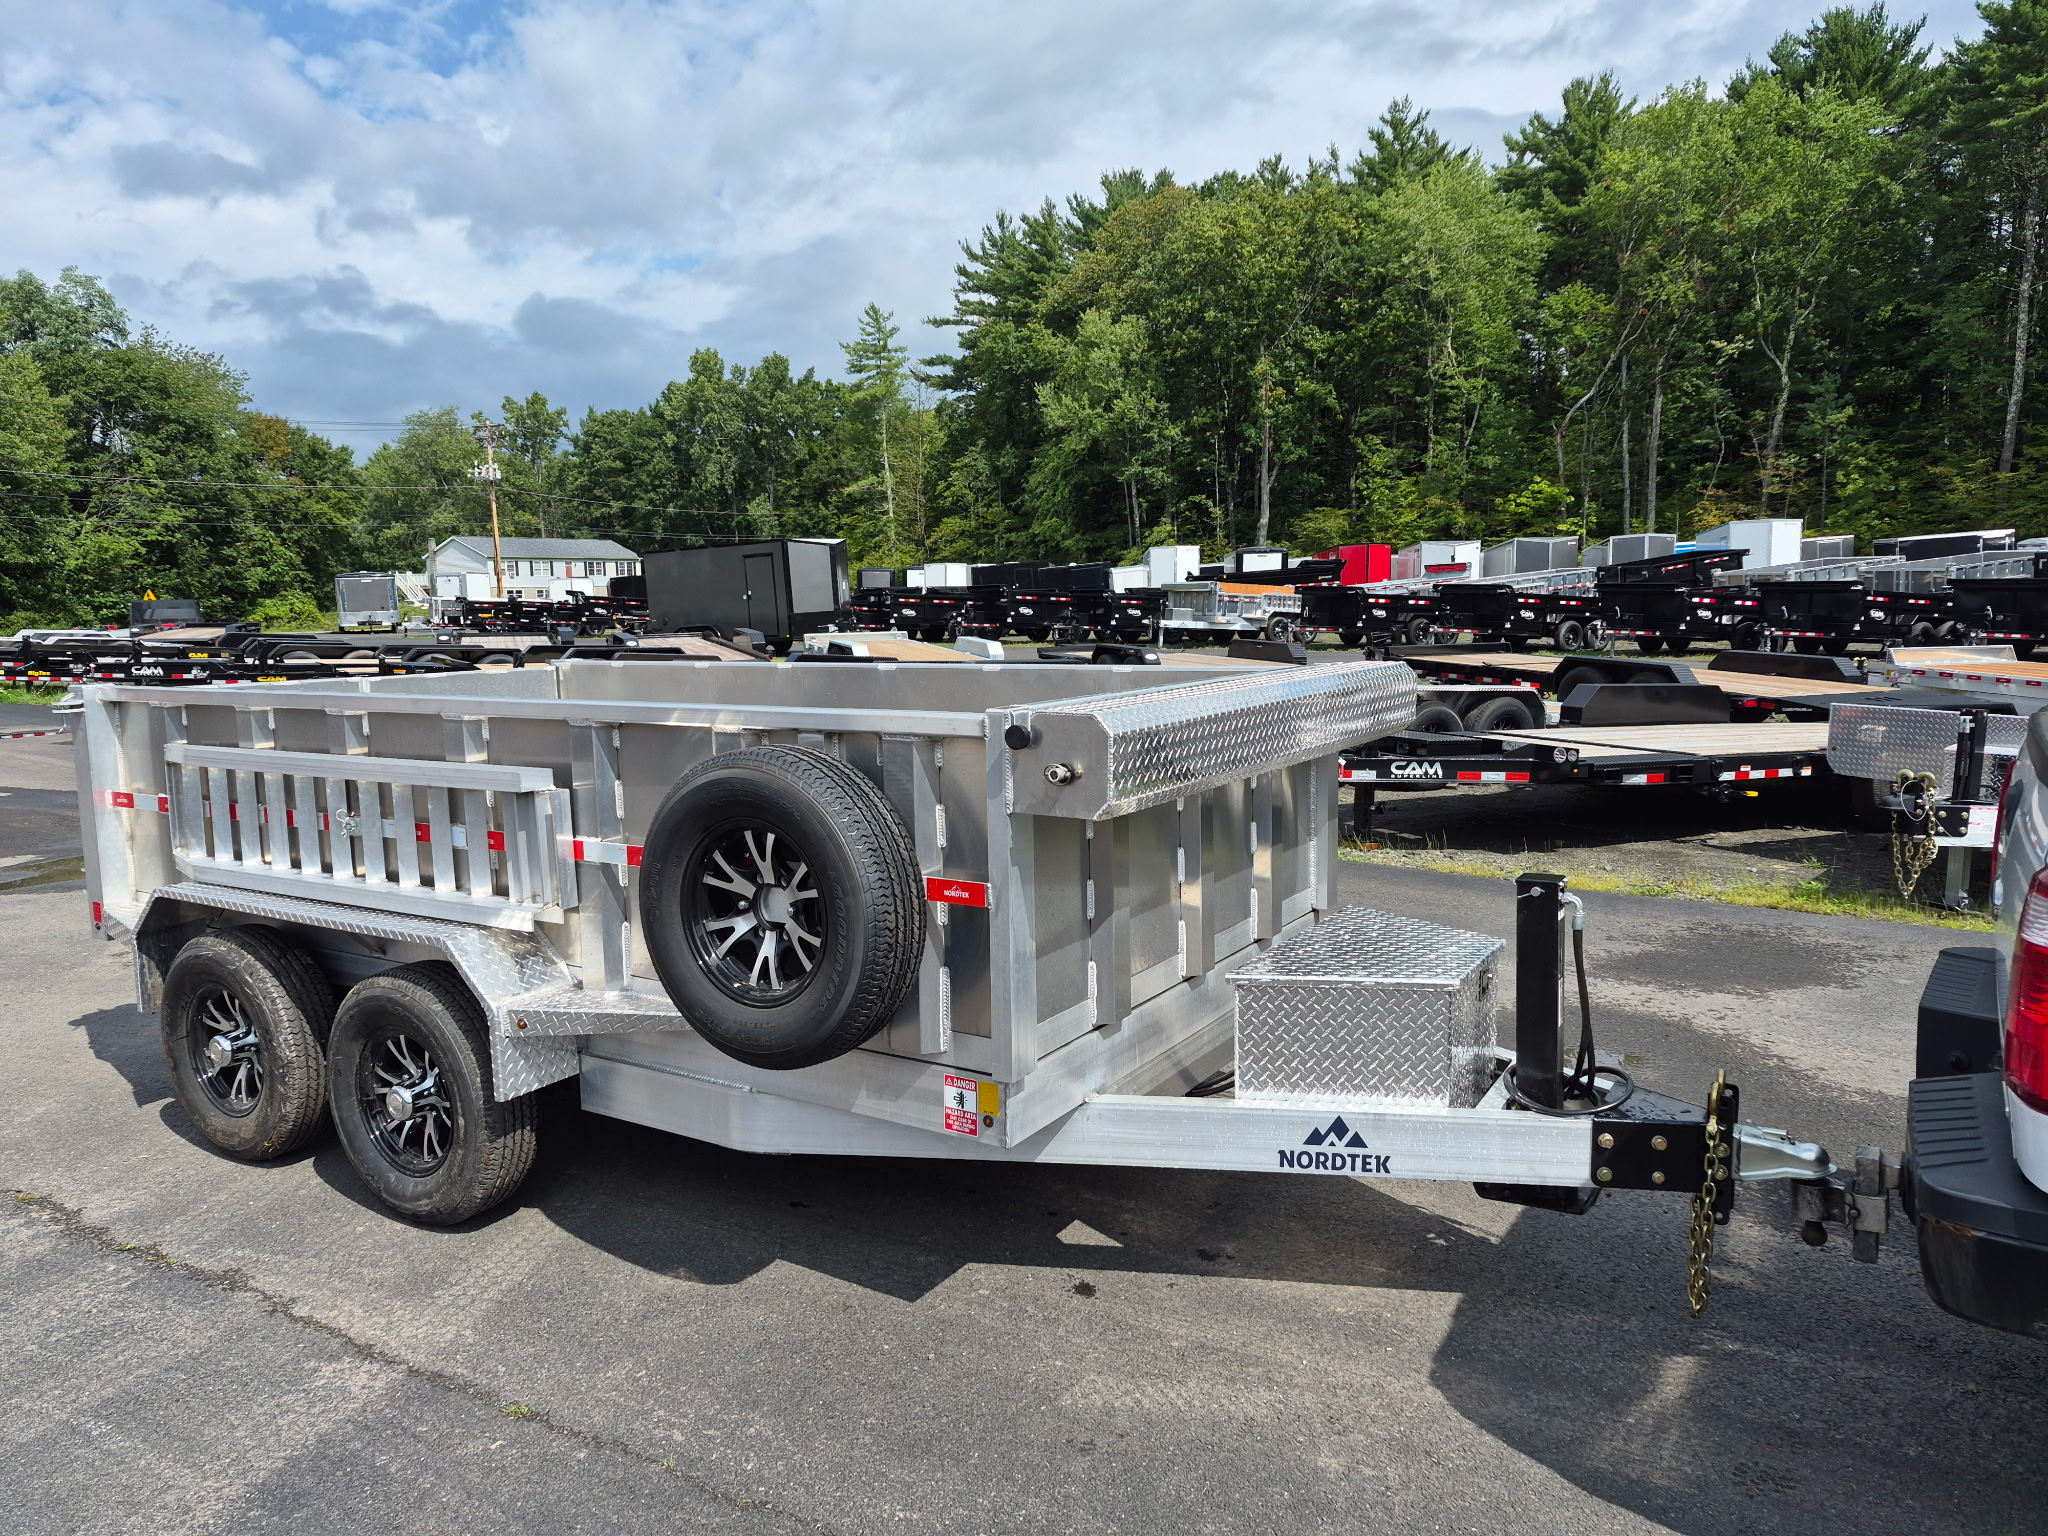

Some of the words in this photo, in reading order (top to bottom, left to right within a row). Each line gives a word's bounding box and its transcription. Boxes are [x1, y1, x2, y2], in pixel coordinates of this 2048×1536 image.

[131, 665, 164, 675] CAM
[1390, 761, 1443, 775] CAM
[943, 889, 970, 898] NORDTEK
[953, 1077, 975, 1090] DANGER
[945, 1107, 963, 1117] HAZARD
[1277, 1150, 1391, 1174] NORDTEK
